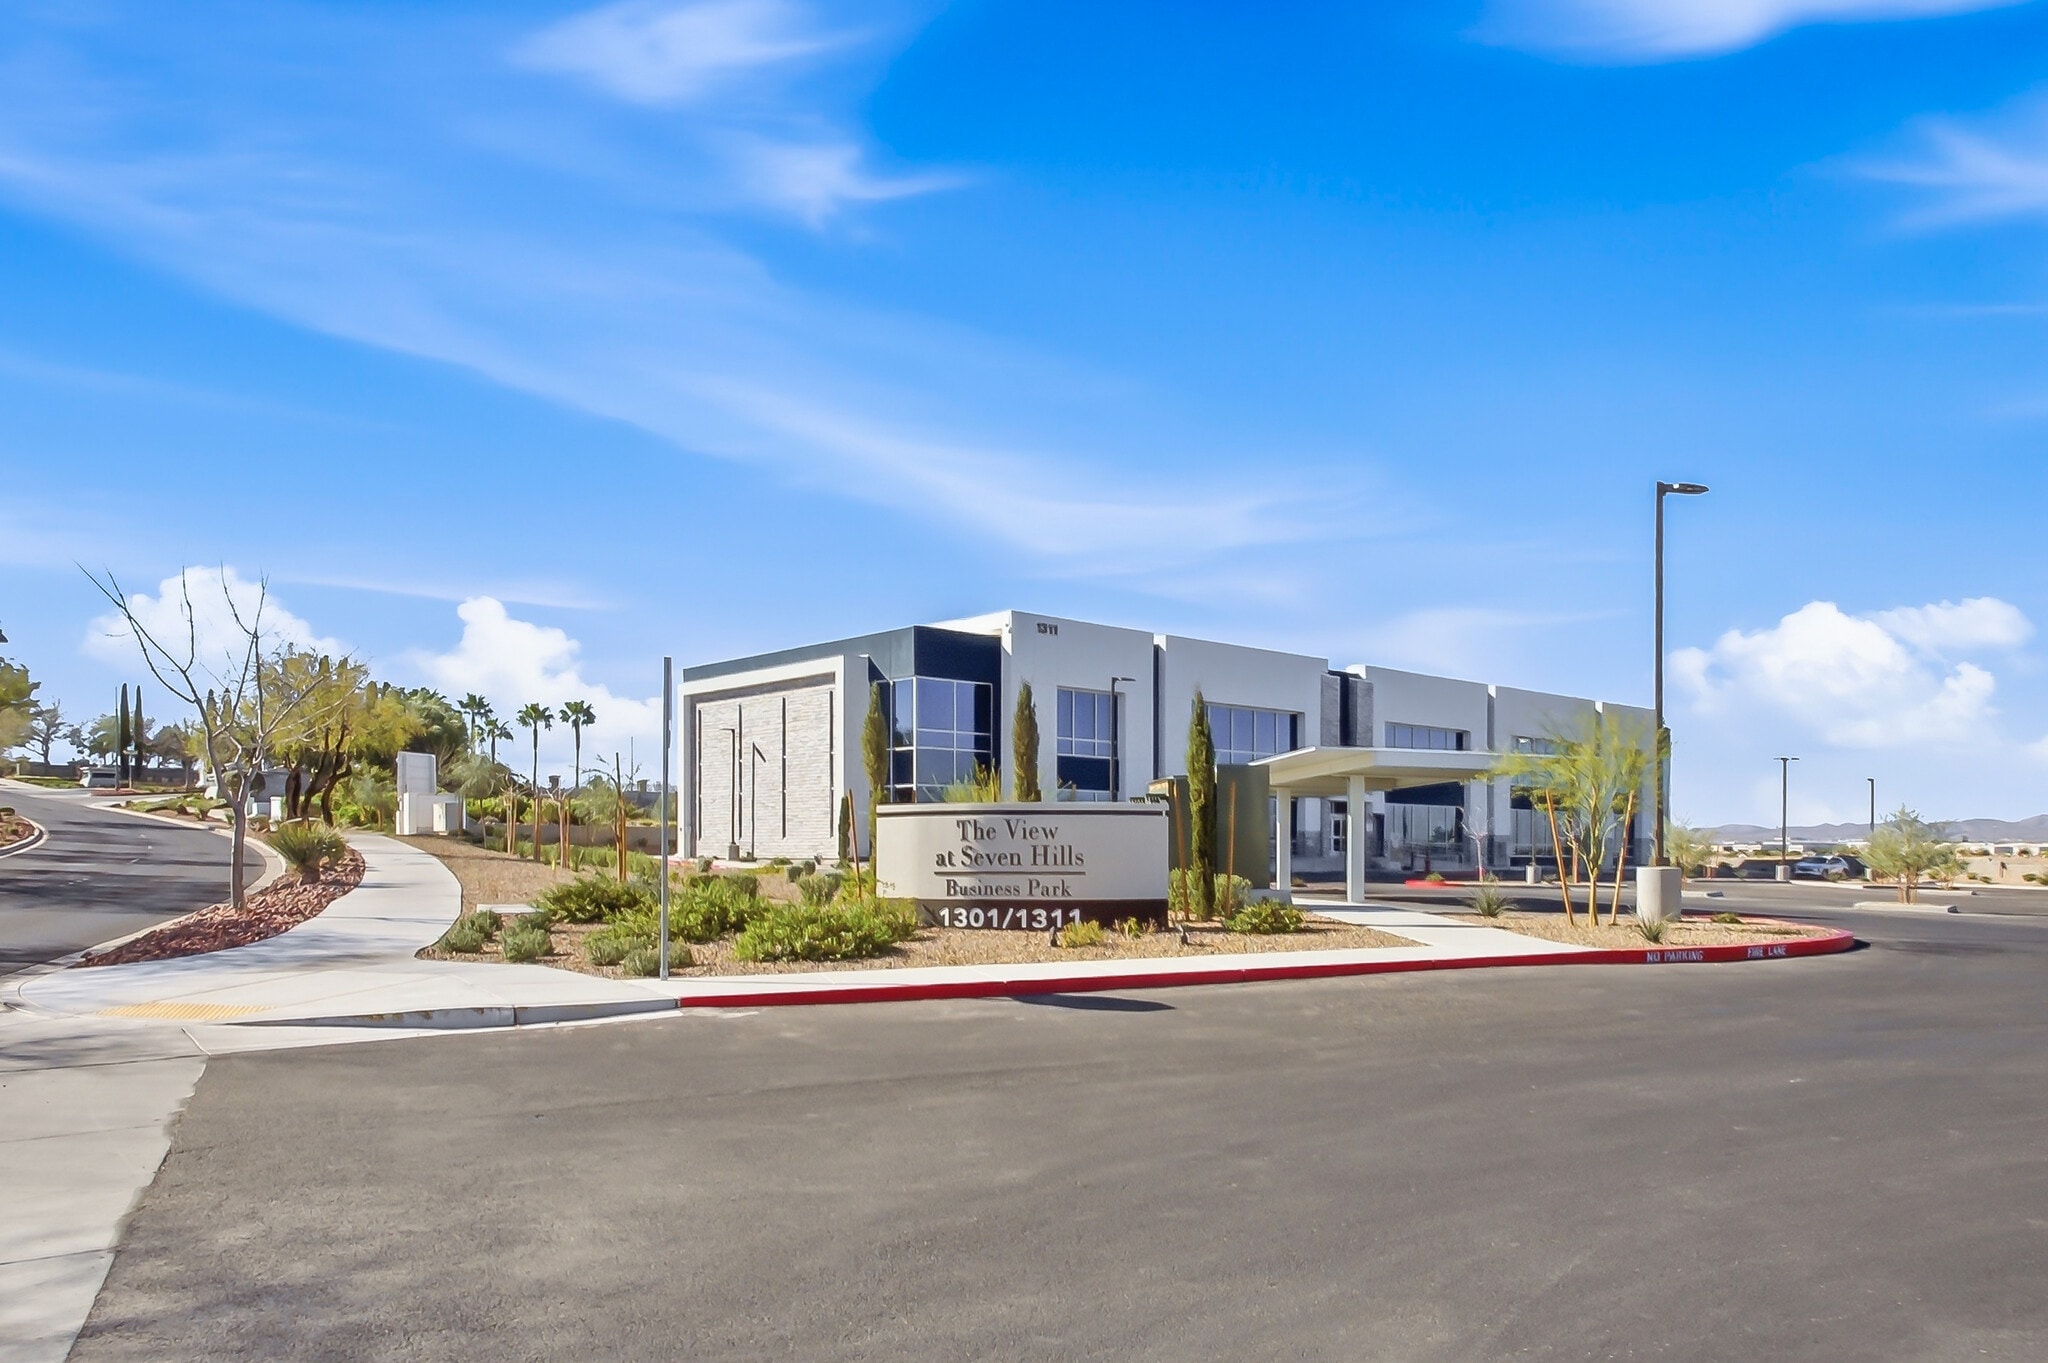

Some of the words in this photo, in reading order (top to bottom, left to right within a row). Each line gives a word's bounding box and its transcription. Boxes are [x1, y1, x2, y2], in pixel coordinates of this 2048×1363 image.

[1037, 623, 1058, 636] 1311
[956, 819, 997, 842] The
[1004, 818, 1059, 840] View
[935, 850, 956, 867] at
[961, 845, 1022, 867] Seven
[1031, 845, 1085, 867] Hills
[945, 878, 1020, 897] Business
[1027, 878, 1072, 897] Park
[938, 907, 1082, 929] 1301/1311
[1646, 952, 1661, 962] NO
[1664, 950, 1704, 962] PARKING
[1768, 945, 1787, 956] LANE
